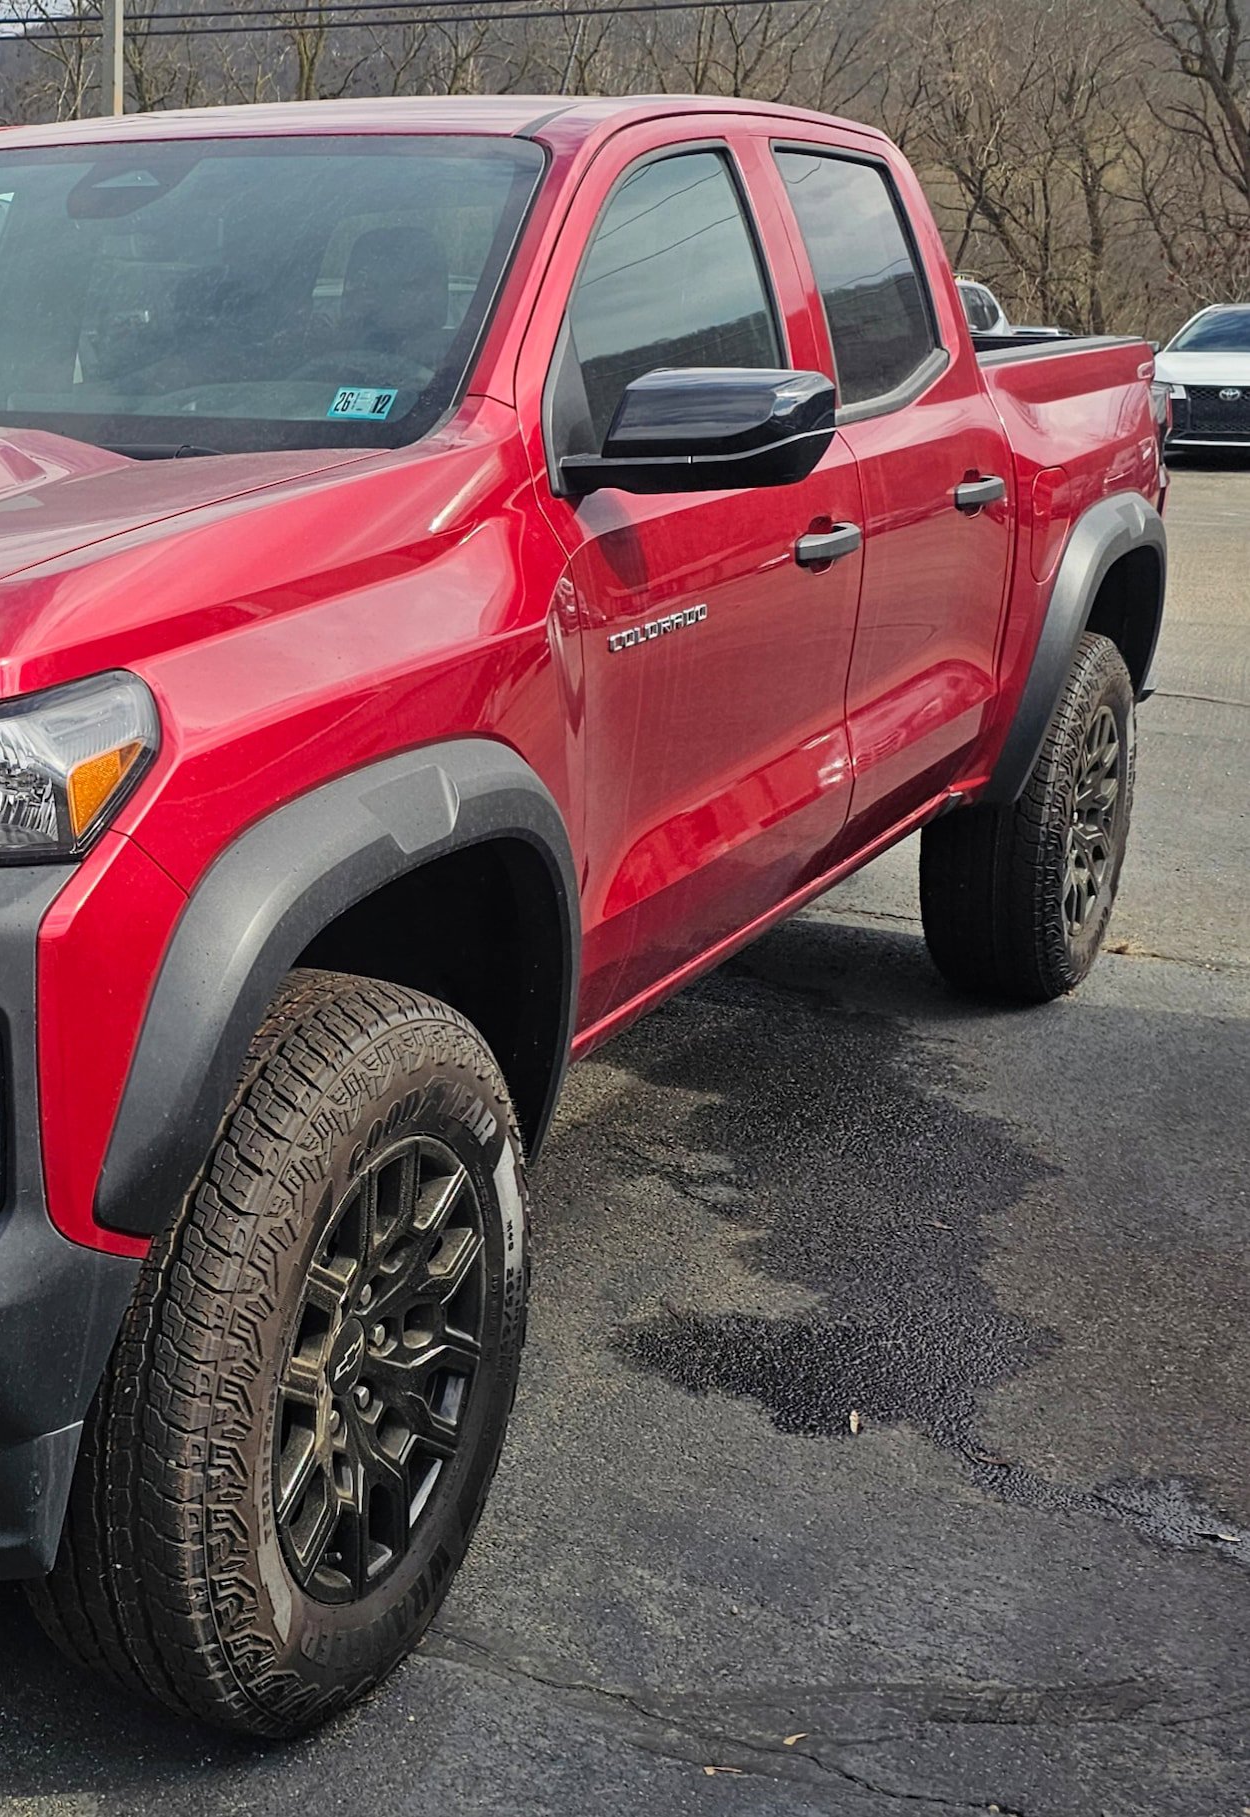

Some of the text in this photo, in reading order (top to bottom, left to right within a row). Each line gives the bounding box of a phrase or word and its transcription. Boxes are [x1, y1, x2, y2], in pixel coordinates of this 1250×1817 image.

[333, 391, 392, 414] 26 12
[608, 603, 708, 652] COLORADO
